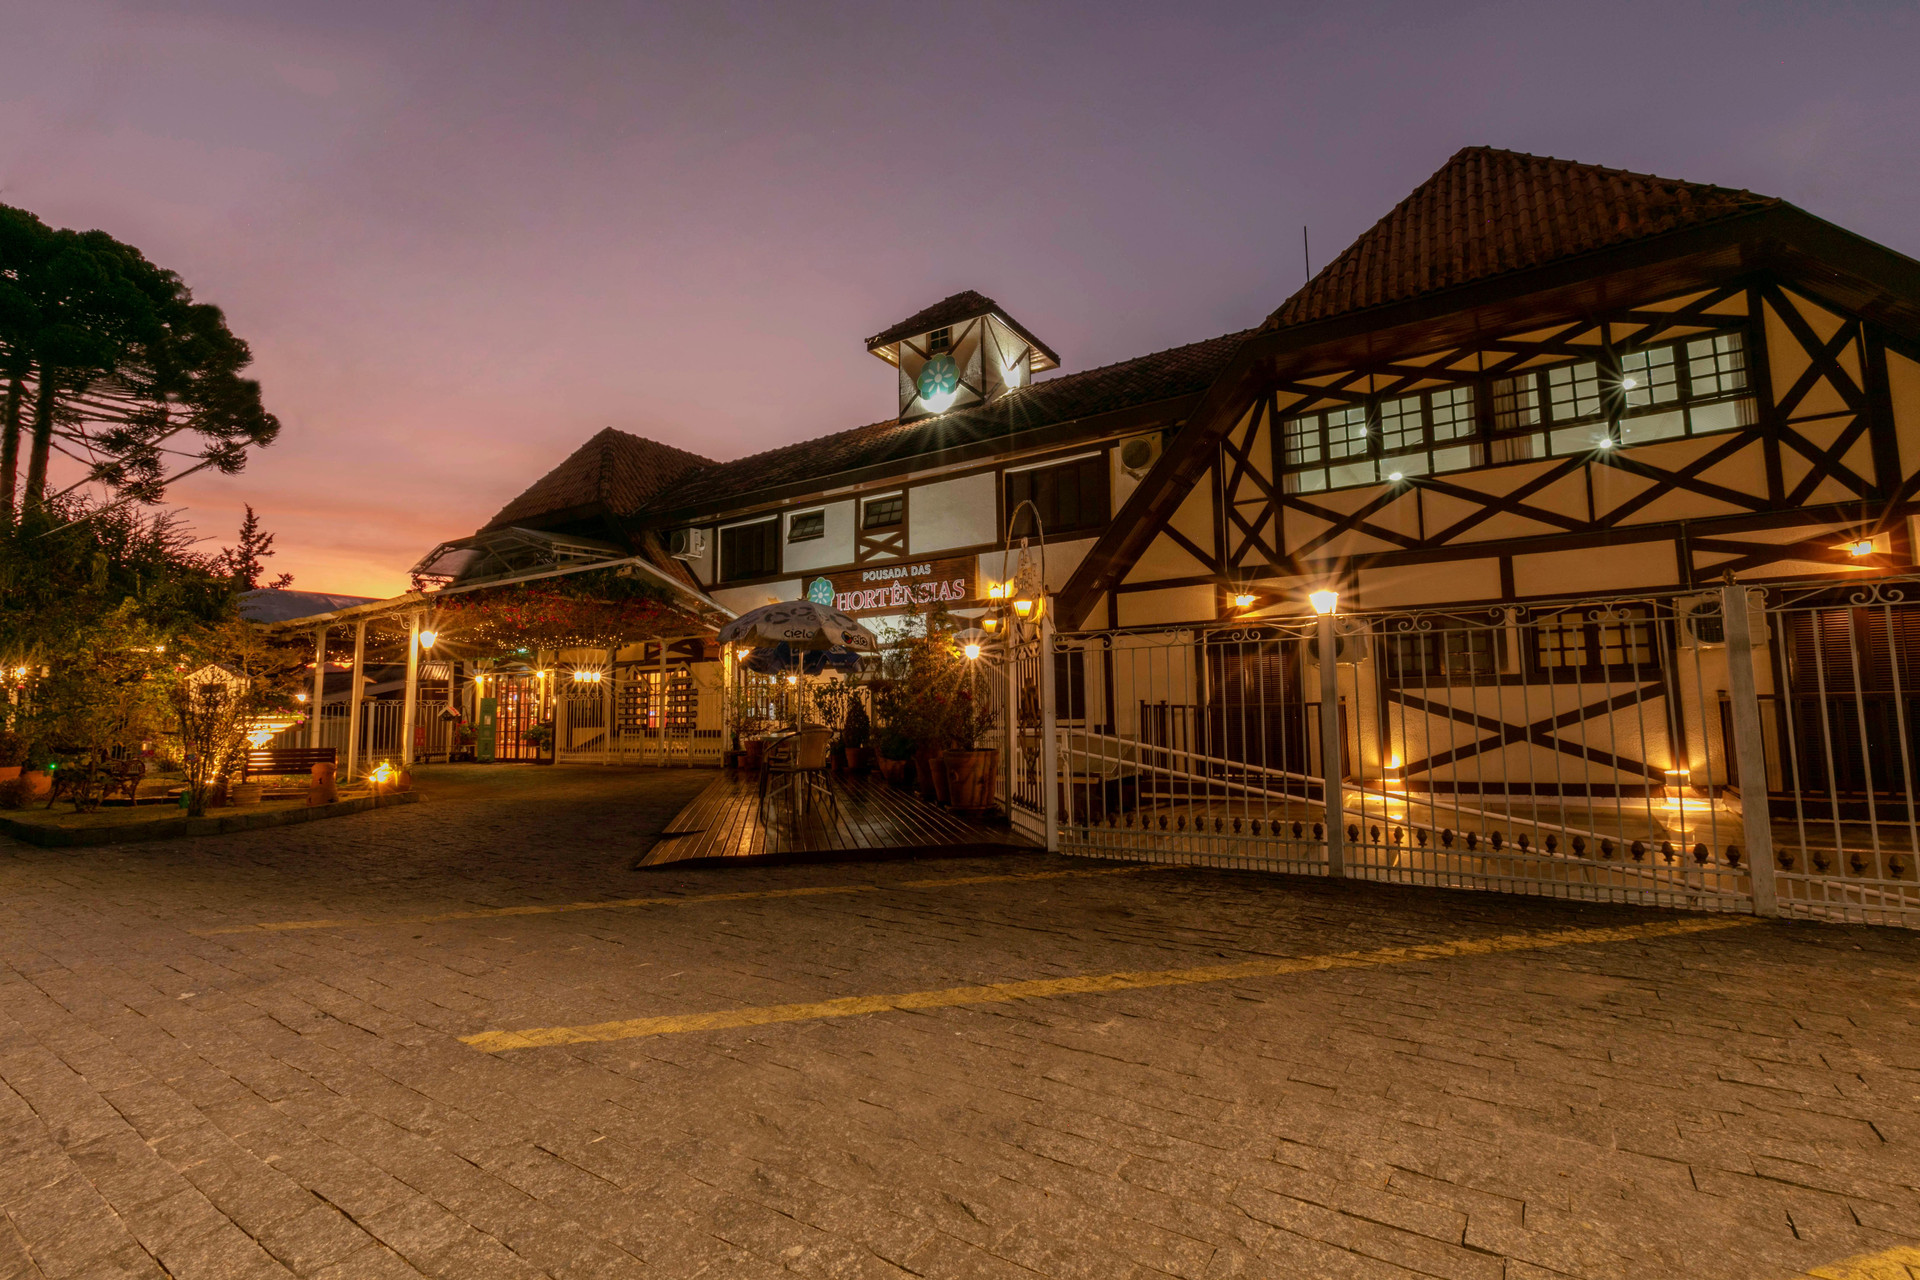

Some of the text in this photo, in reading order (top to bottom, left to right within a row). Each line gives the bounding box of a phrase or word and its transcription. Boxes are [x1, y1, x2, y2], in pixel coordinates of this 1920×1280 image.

[863, 564, 931, 582] POUSADA DAS
[783, 628, 815, 640] cielo
